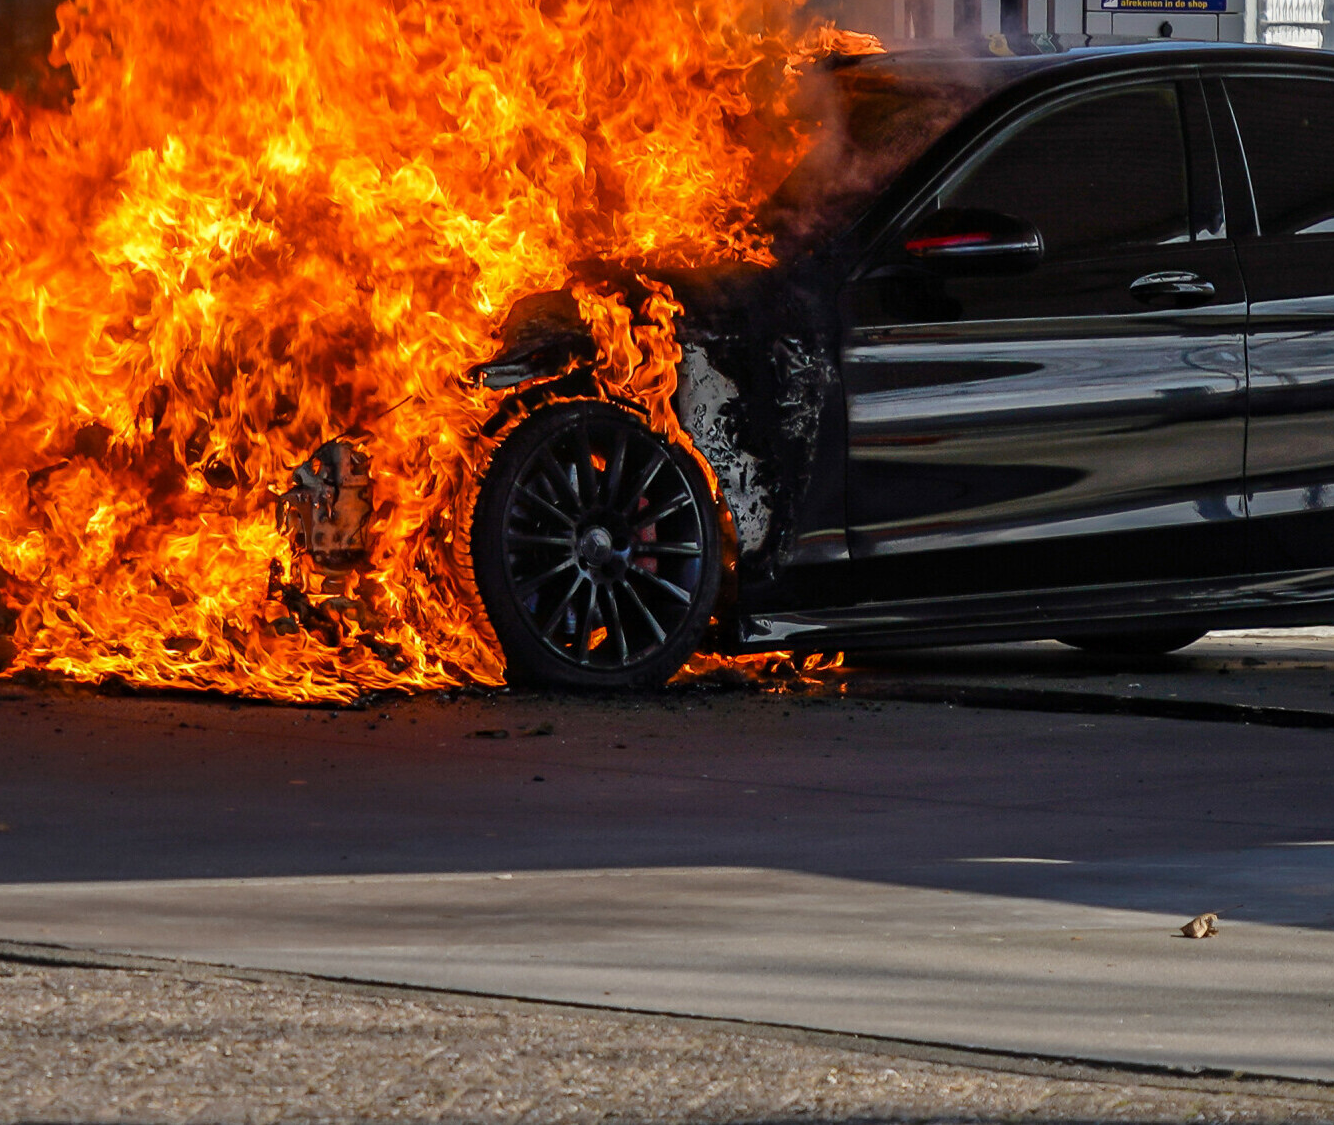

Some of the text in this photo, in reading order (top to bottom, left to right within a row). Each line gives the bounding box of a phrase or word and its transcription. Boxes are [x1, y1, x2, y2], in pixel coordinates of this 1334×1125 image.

[1121, 0, 1208, 9] afrekenen in de shop
